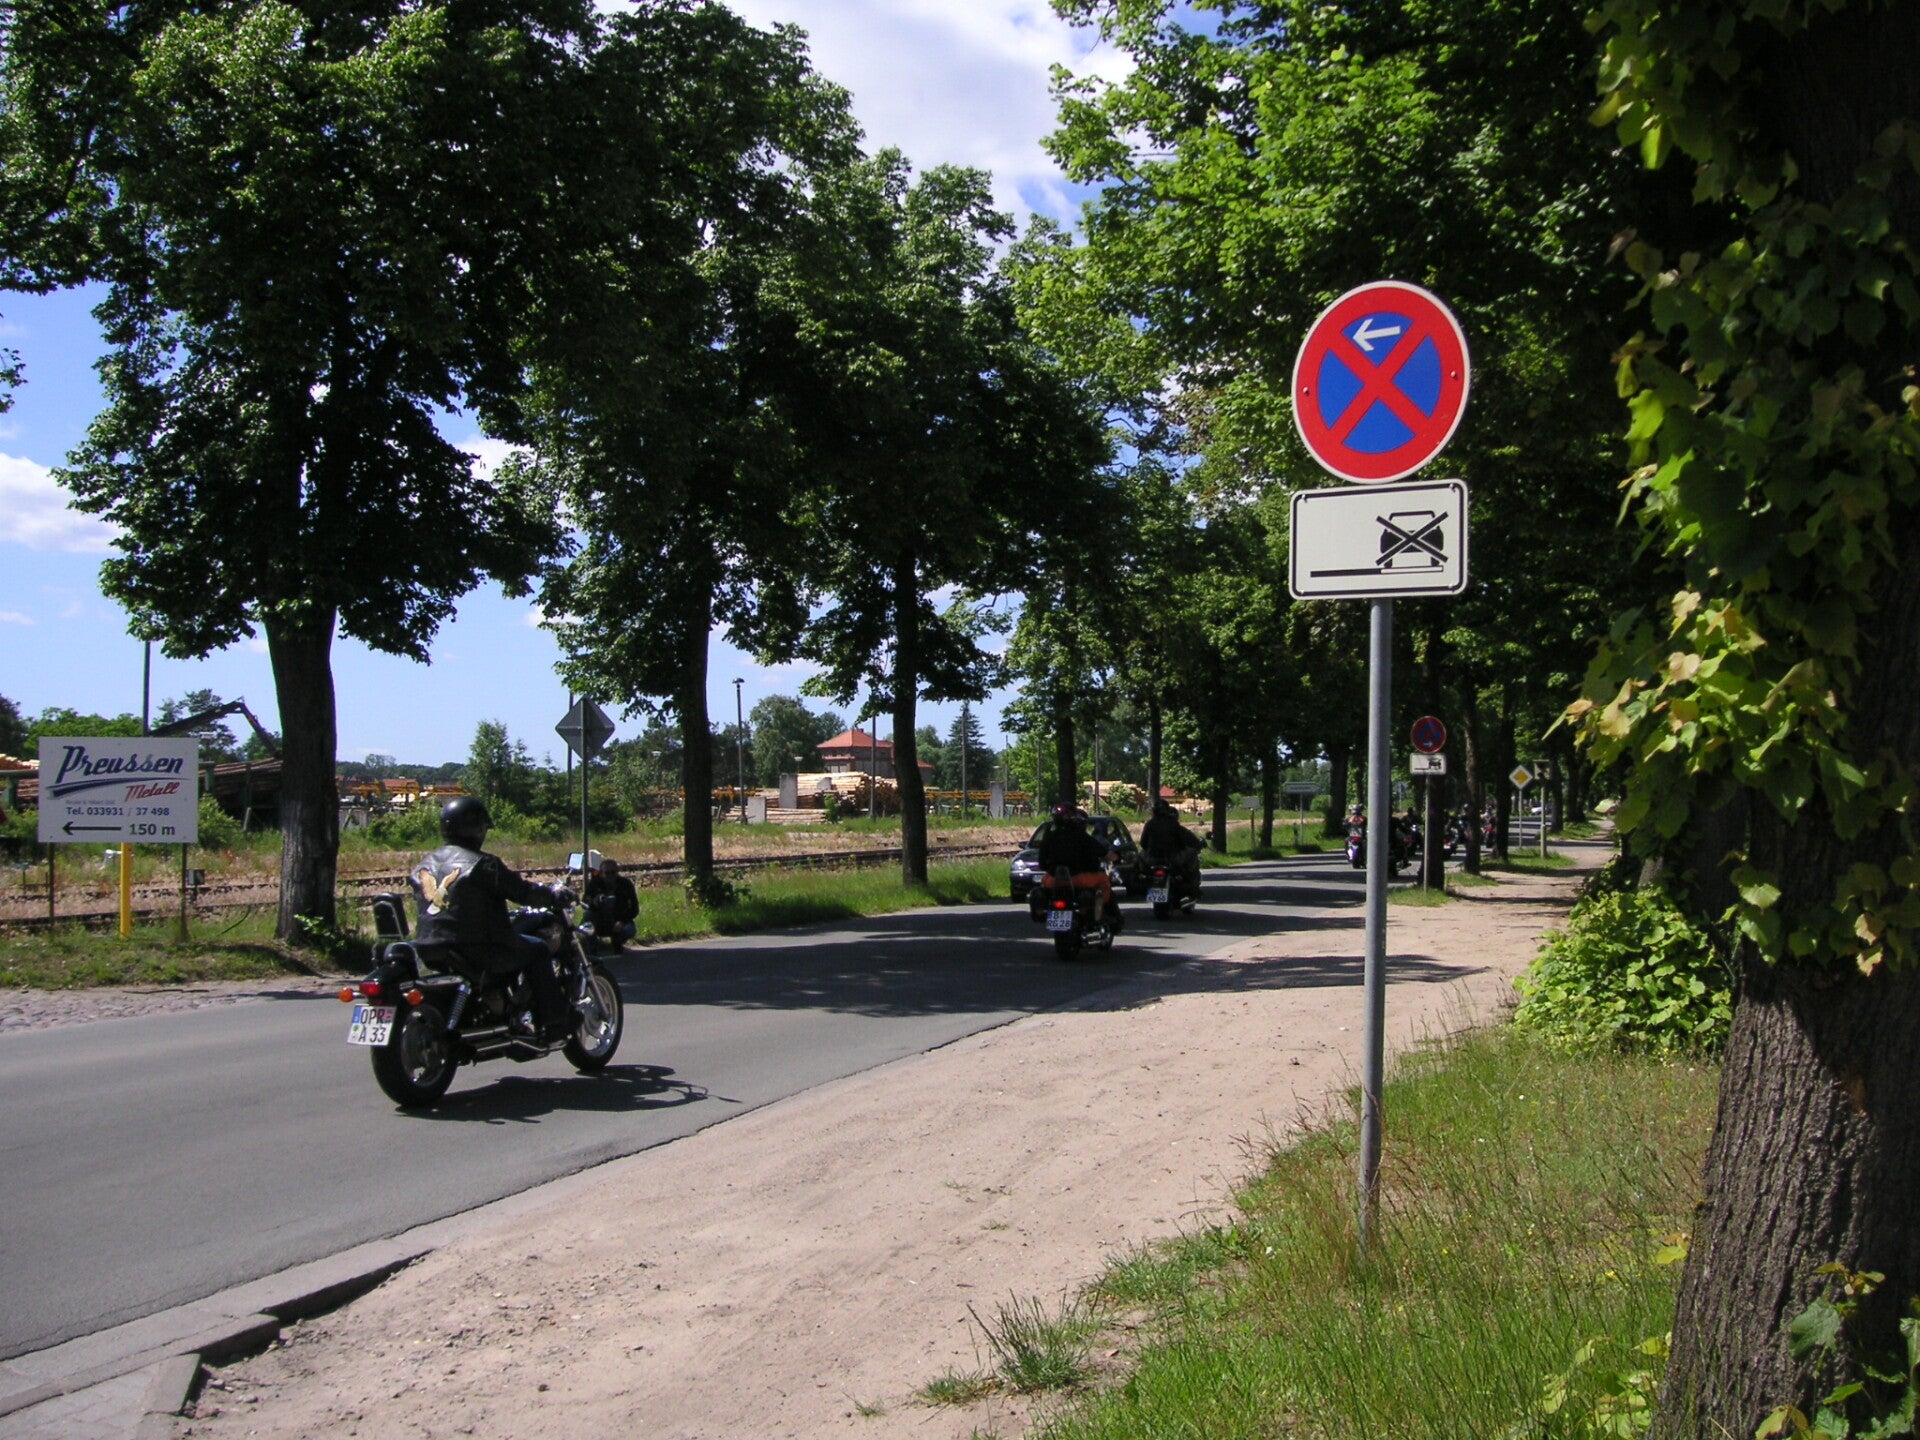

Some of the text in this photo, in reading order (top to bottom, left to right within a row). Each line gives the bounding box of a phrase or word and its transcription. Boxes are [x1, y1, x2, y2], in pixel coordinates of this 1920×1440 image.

[55, 745, 184, 784] Preussen
[124, 781, 181, 802] Metall
[66, 806, 84, 816] Tel.
[86, 807, 124, 816] 033931
[135, 807, 150, 816] 37
[151, 807, 170, 816] 498
[129, 823, 175, 836] 150 m
[360, 1008, 385, 1024] OPR
[358, 1025, 387, 1043] A 33
